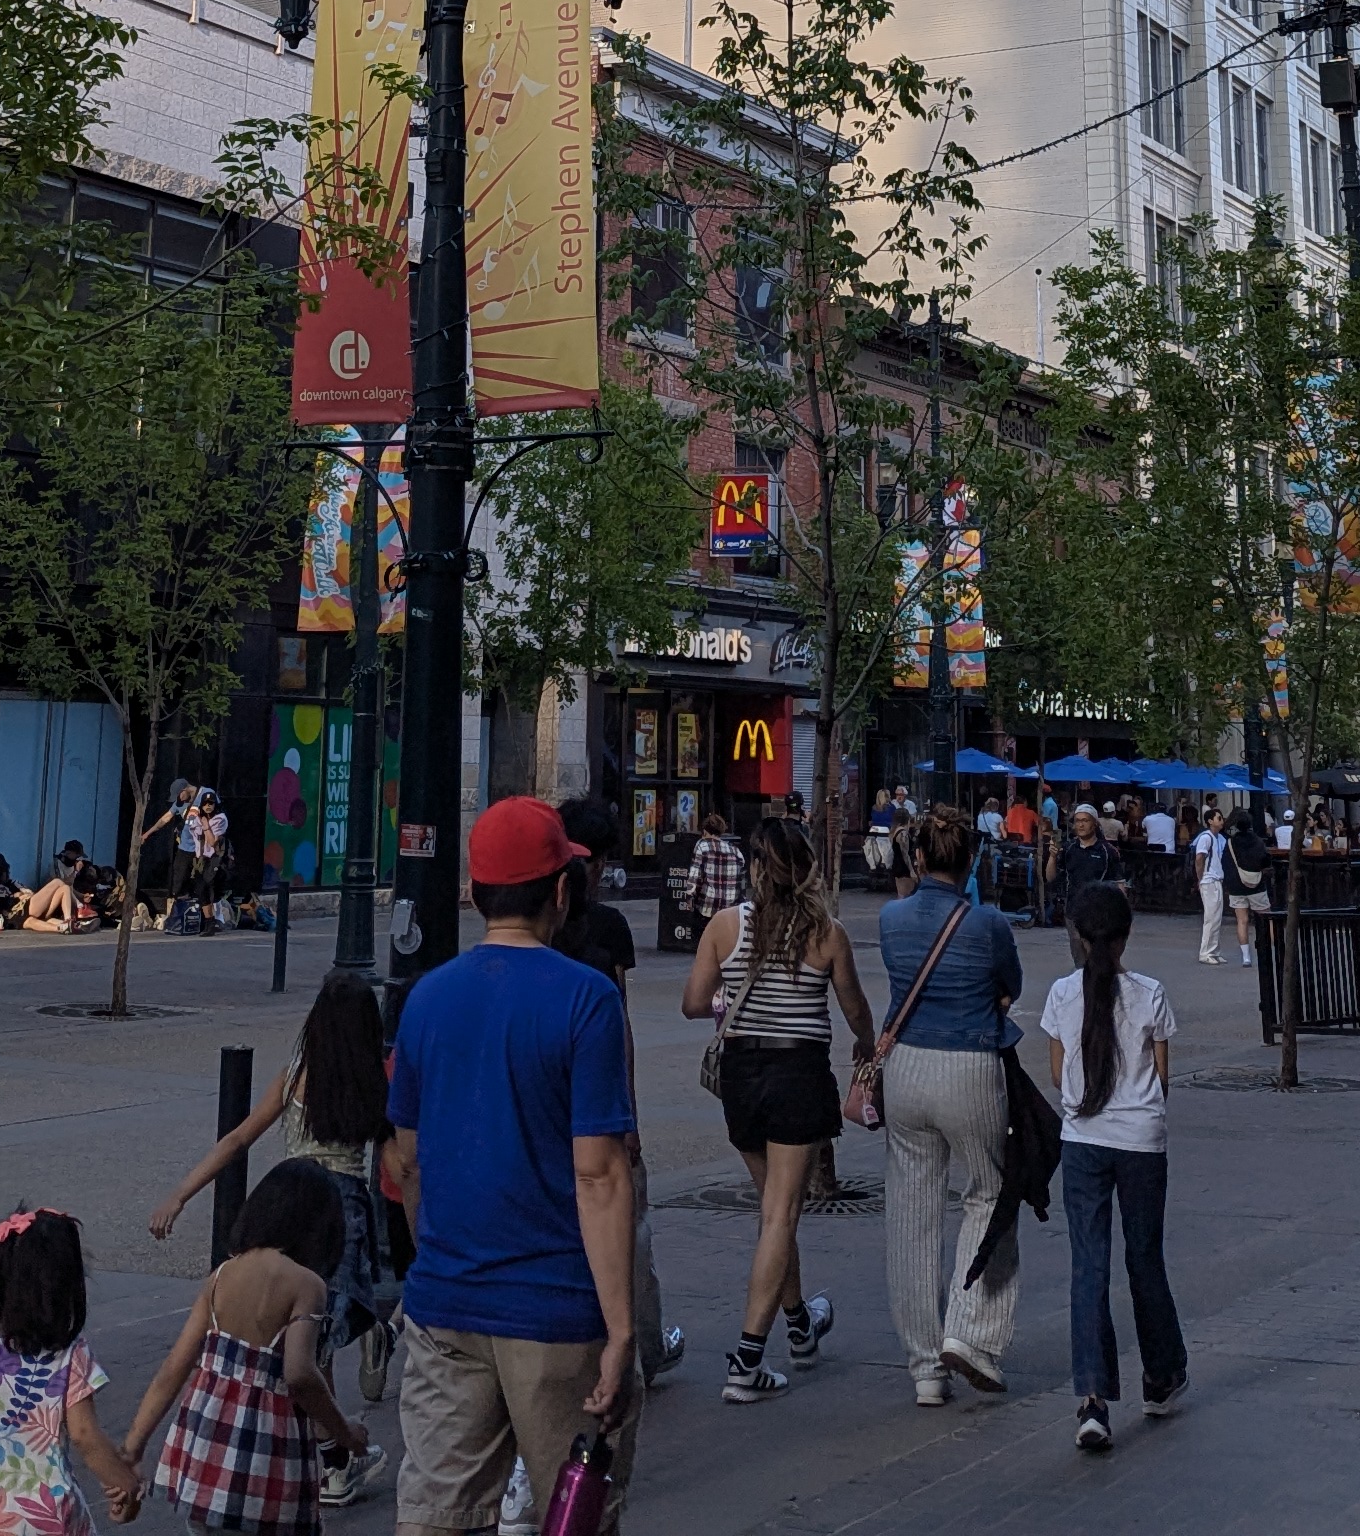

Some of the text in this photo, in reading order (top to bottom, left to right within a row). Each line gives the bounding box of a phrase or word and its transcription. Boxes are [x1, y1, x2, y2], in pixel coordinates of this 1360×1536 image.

[551, 2, 580, 133] Avenue
[552, 145, 589, 294] Stephen
[300, 386, 405, 402] downtown calgary
[624, 624, 752, 663] Donald's
[673, 890, 688, 899] LEFT
